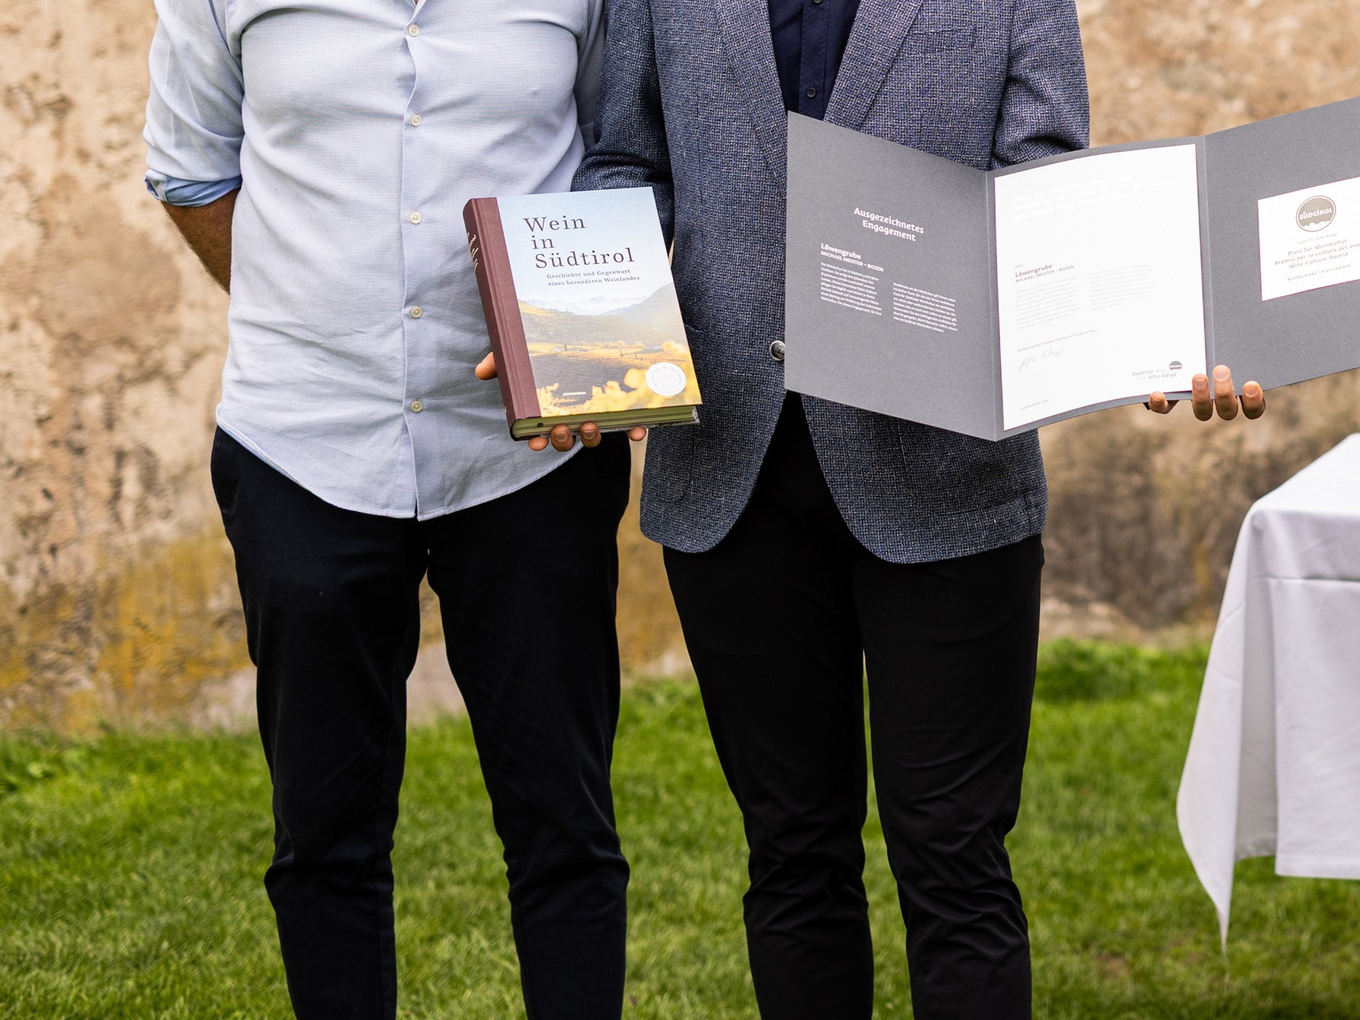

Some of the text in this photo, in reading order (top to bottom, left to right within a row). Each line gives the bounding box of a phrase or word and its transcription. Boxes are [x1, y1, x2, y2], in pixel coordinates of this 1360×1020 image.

[522, 215, 586, 232] Wein
[853, 207, 924, 234] Ausgezeichnetes
[862, 219, 916, 242] Engagement
[531, 235, 555, 250] in
[820, 242, 862, 260] Löwengrube
[535, 247, 635, 269] Südtirol
[596, 269, 631, 277] Gegenwart
